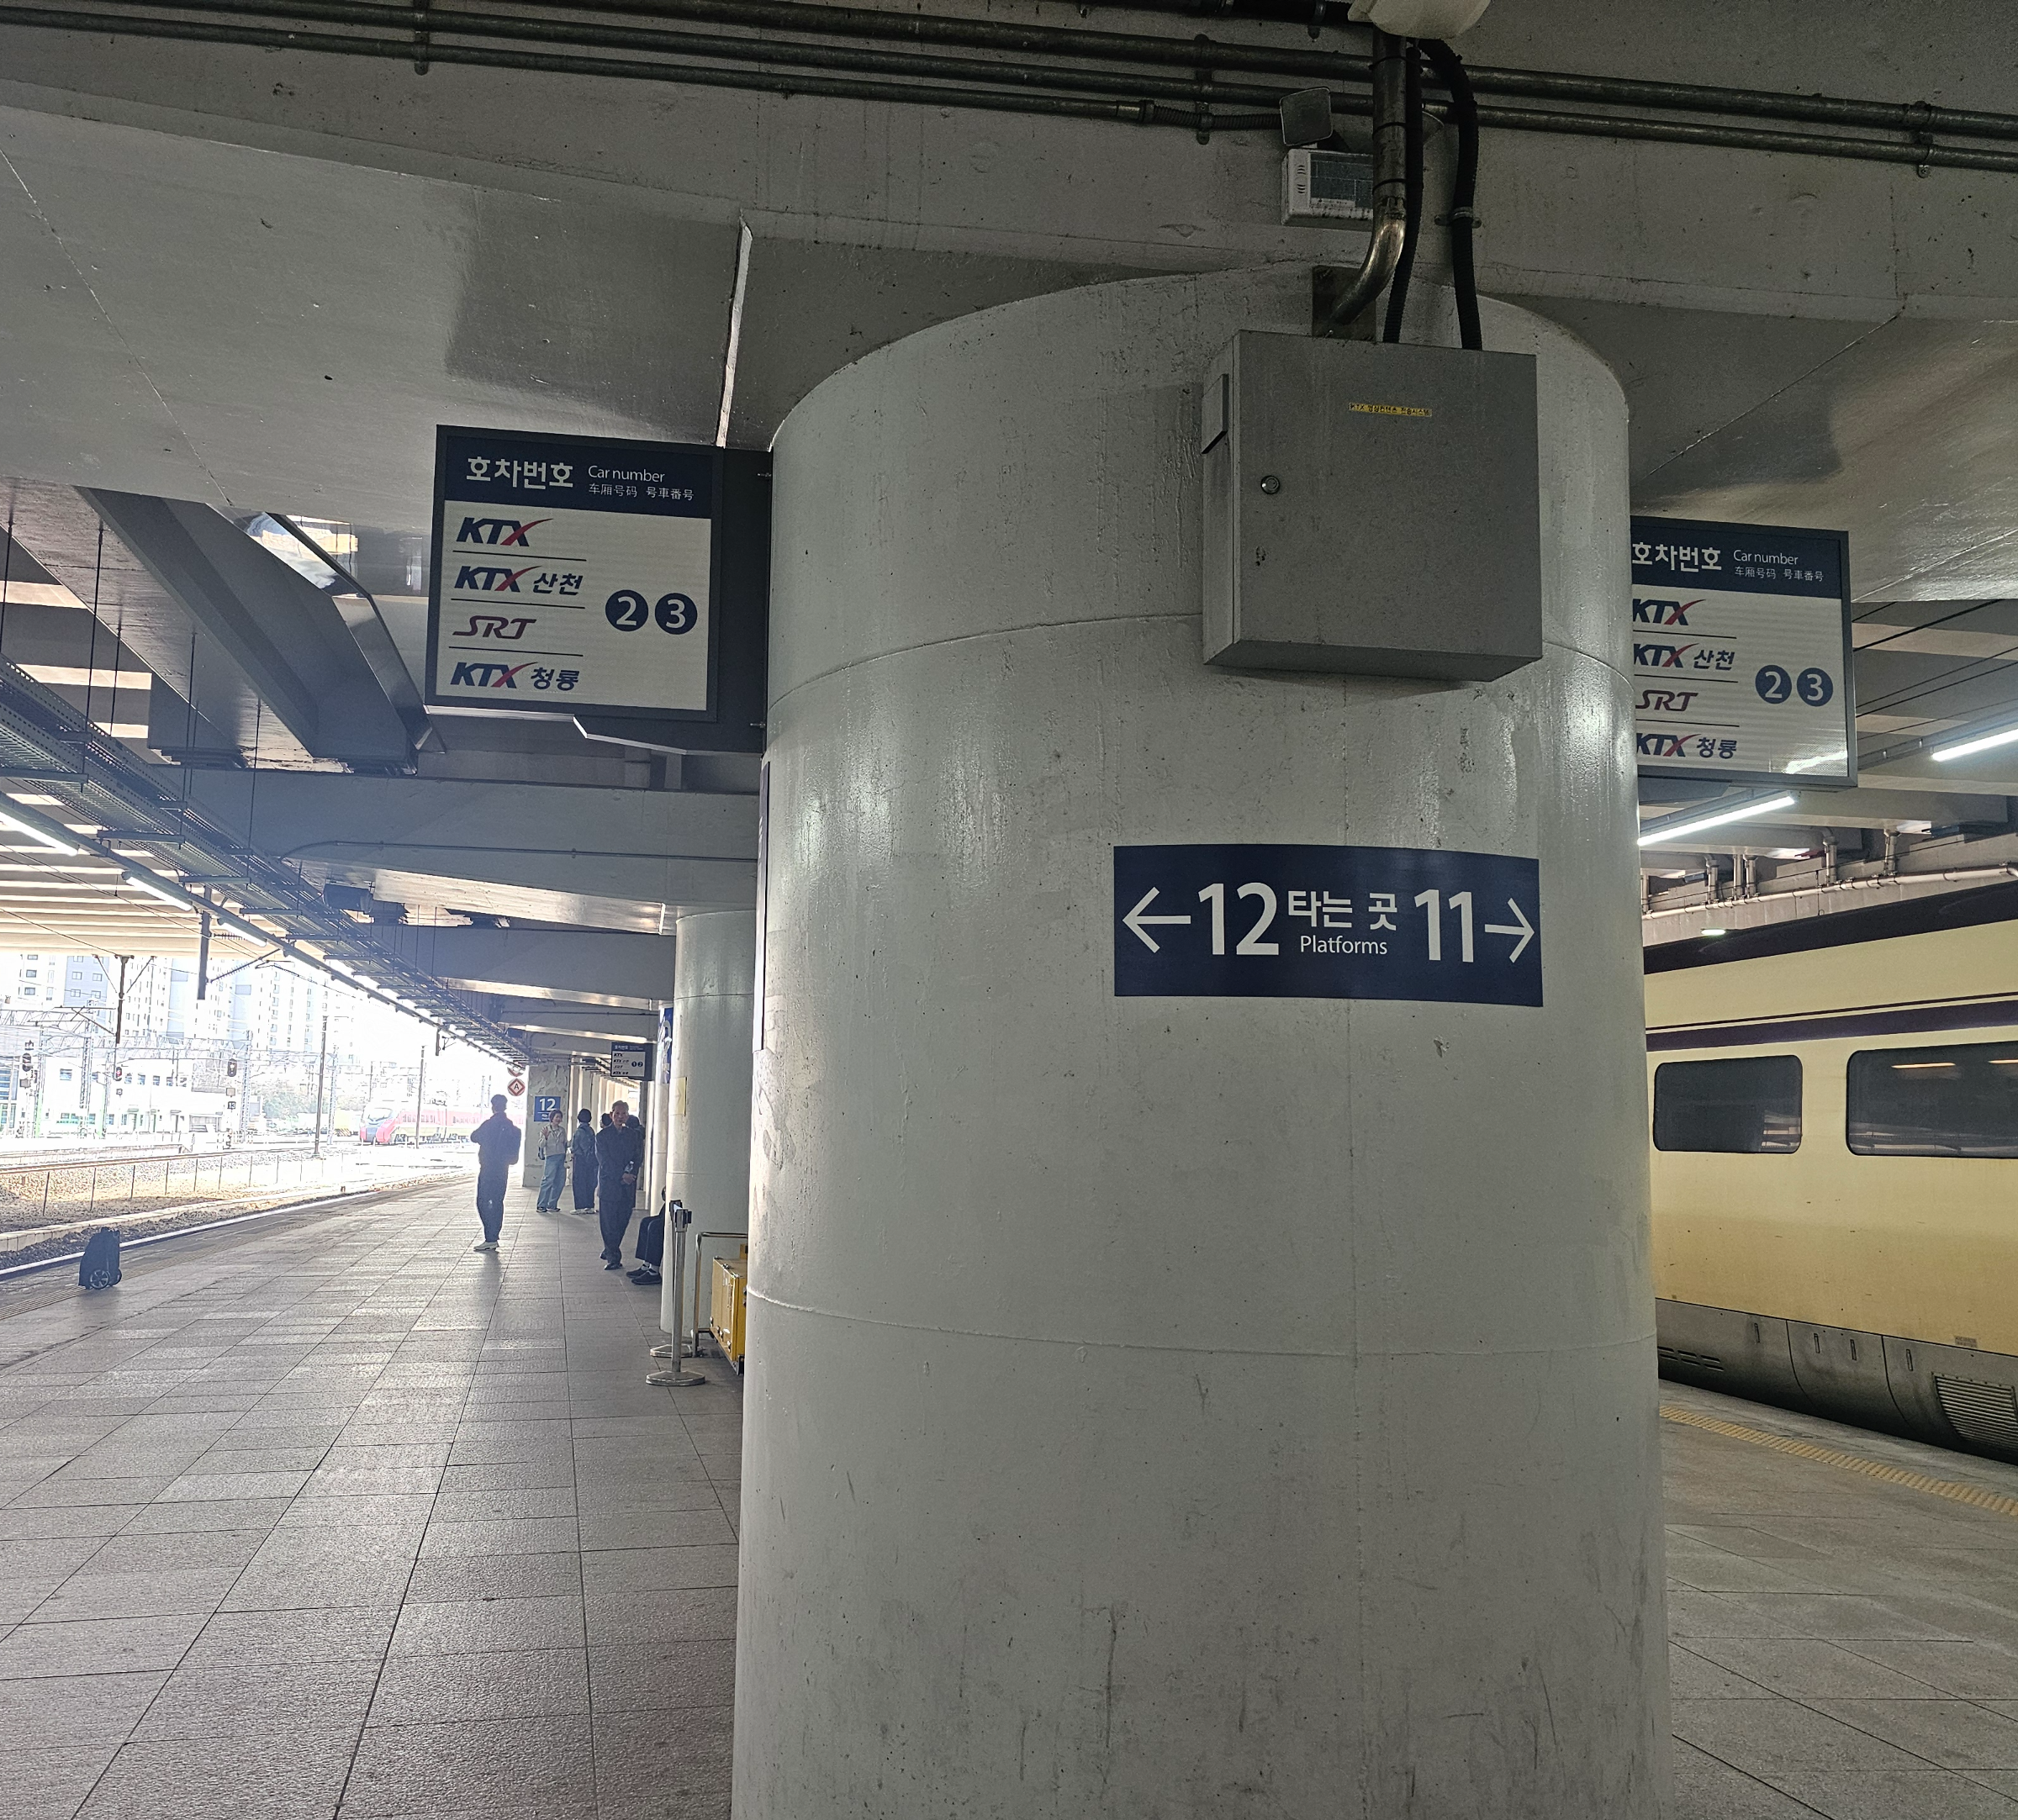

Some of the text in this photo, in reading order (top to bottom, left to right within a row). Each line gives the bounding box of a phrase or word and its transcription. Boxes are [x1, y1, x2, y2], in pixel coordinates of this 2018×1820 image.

[466, 456, 573, 490] 호차번호
[588, 465, 665, 483] Car number
[589, 483, 695, 501] 车厢号码 号車番号
[456, 517, 553, 547] KTX
[1632, 541, 1722, 572] 호차번호
[1733, 549, 1799, 565] Car number
[454, 565, 584, 596] KTX 산천
[1735, 566, 1824, 582] 车厢号码 号車番号
[615, 596, 686, 629] 2 3
[1632, 599, 1706, 625] KTX
[452, 615, 537, 640] SRT
[1634, 643, 1735, 671] KTX 산천
[450, 662, 579, 691] KTX 청룡
[1764, 671, 1824, 701] 2 3
[1635, 689, 1699, 712] SRT
[1635, 732, 1737, 759] KTX 청룡
[1198, 882, 1474, 963] 12 타는 곳 11
[1300, 936, 1387, 955] Platforms
[540, 1098, 556, 1110] 12
